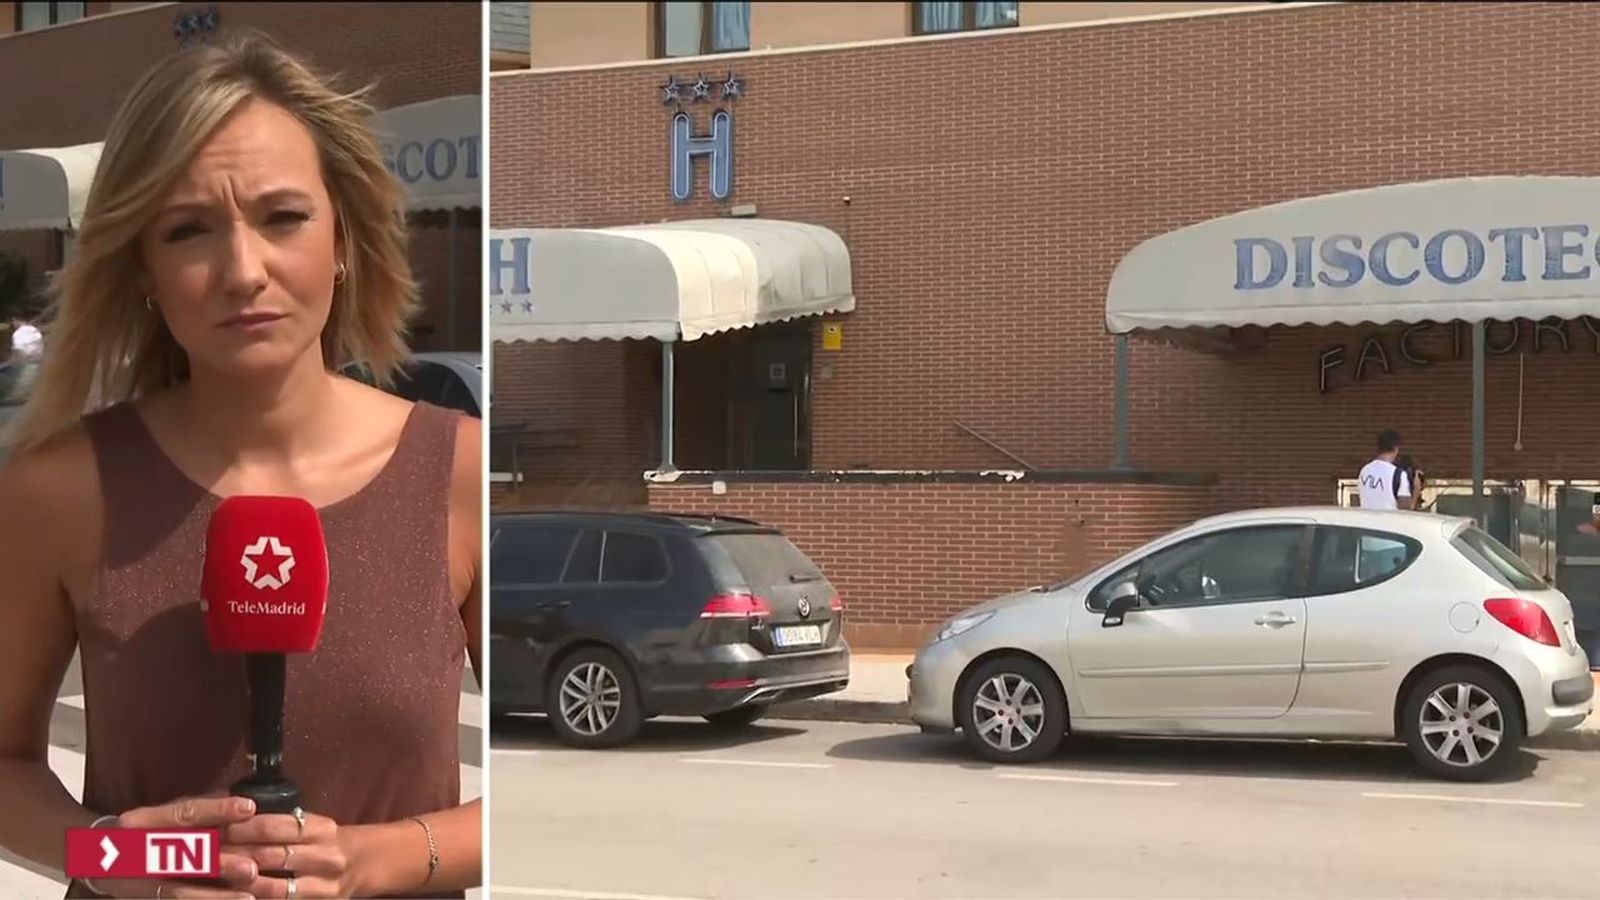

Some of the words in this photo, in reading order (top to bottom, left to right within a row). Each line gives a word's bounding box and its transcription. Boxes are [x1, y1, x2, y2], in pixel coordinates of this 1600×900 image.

[671, 110, 735, 200] H
[1233, 223, 1600, 291] DISCOTE
[227, 600, 306, 616] TeleMadrid
